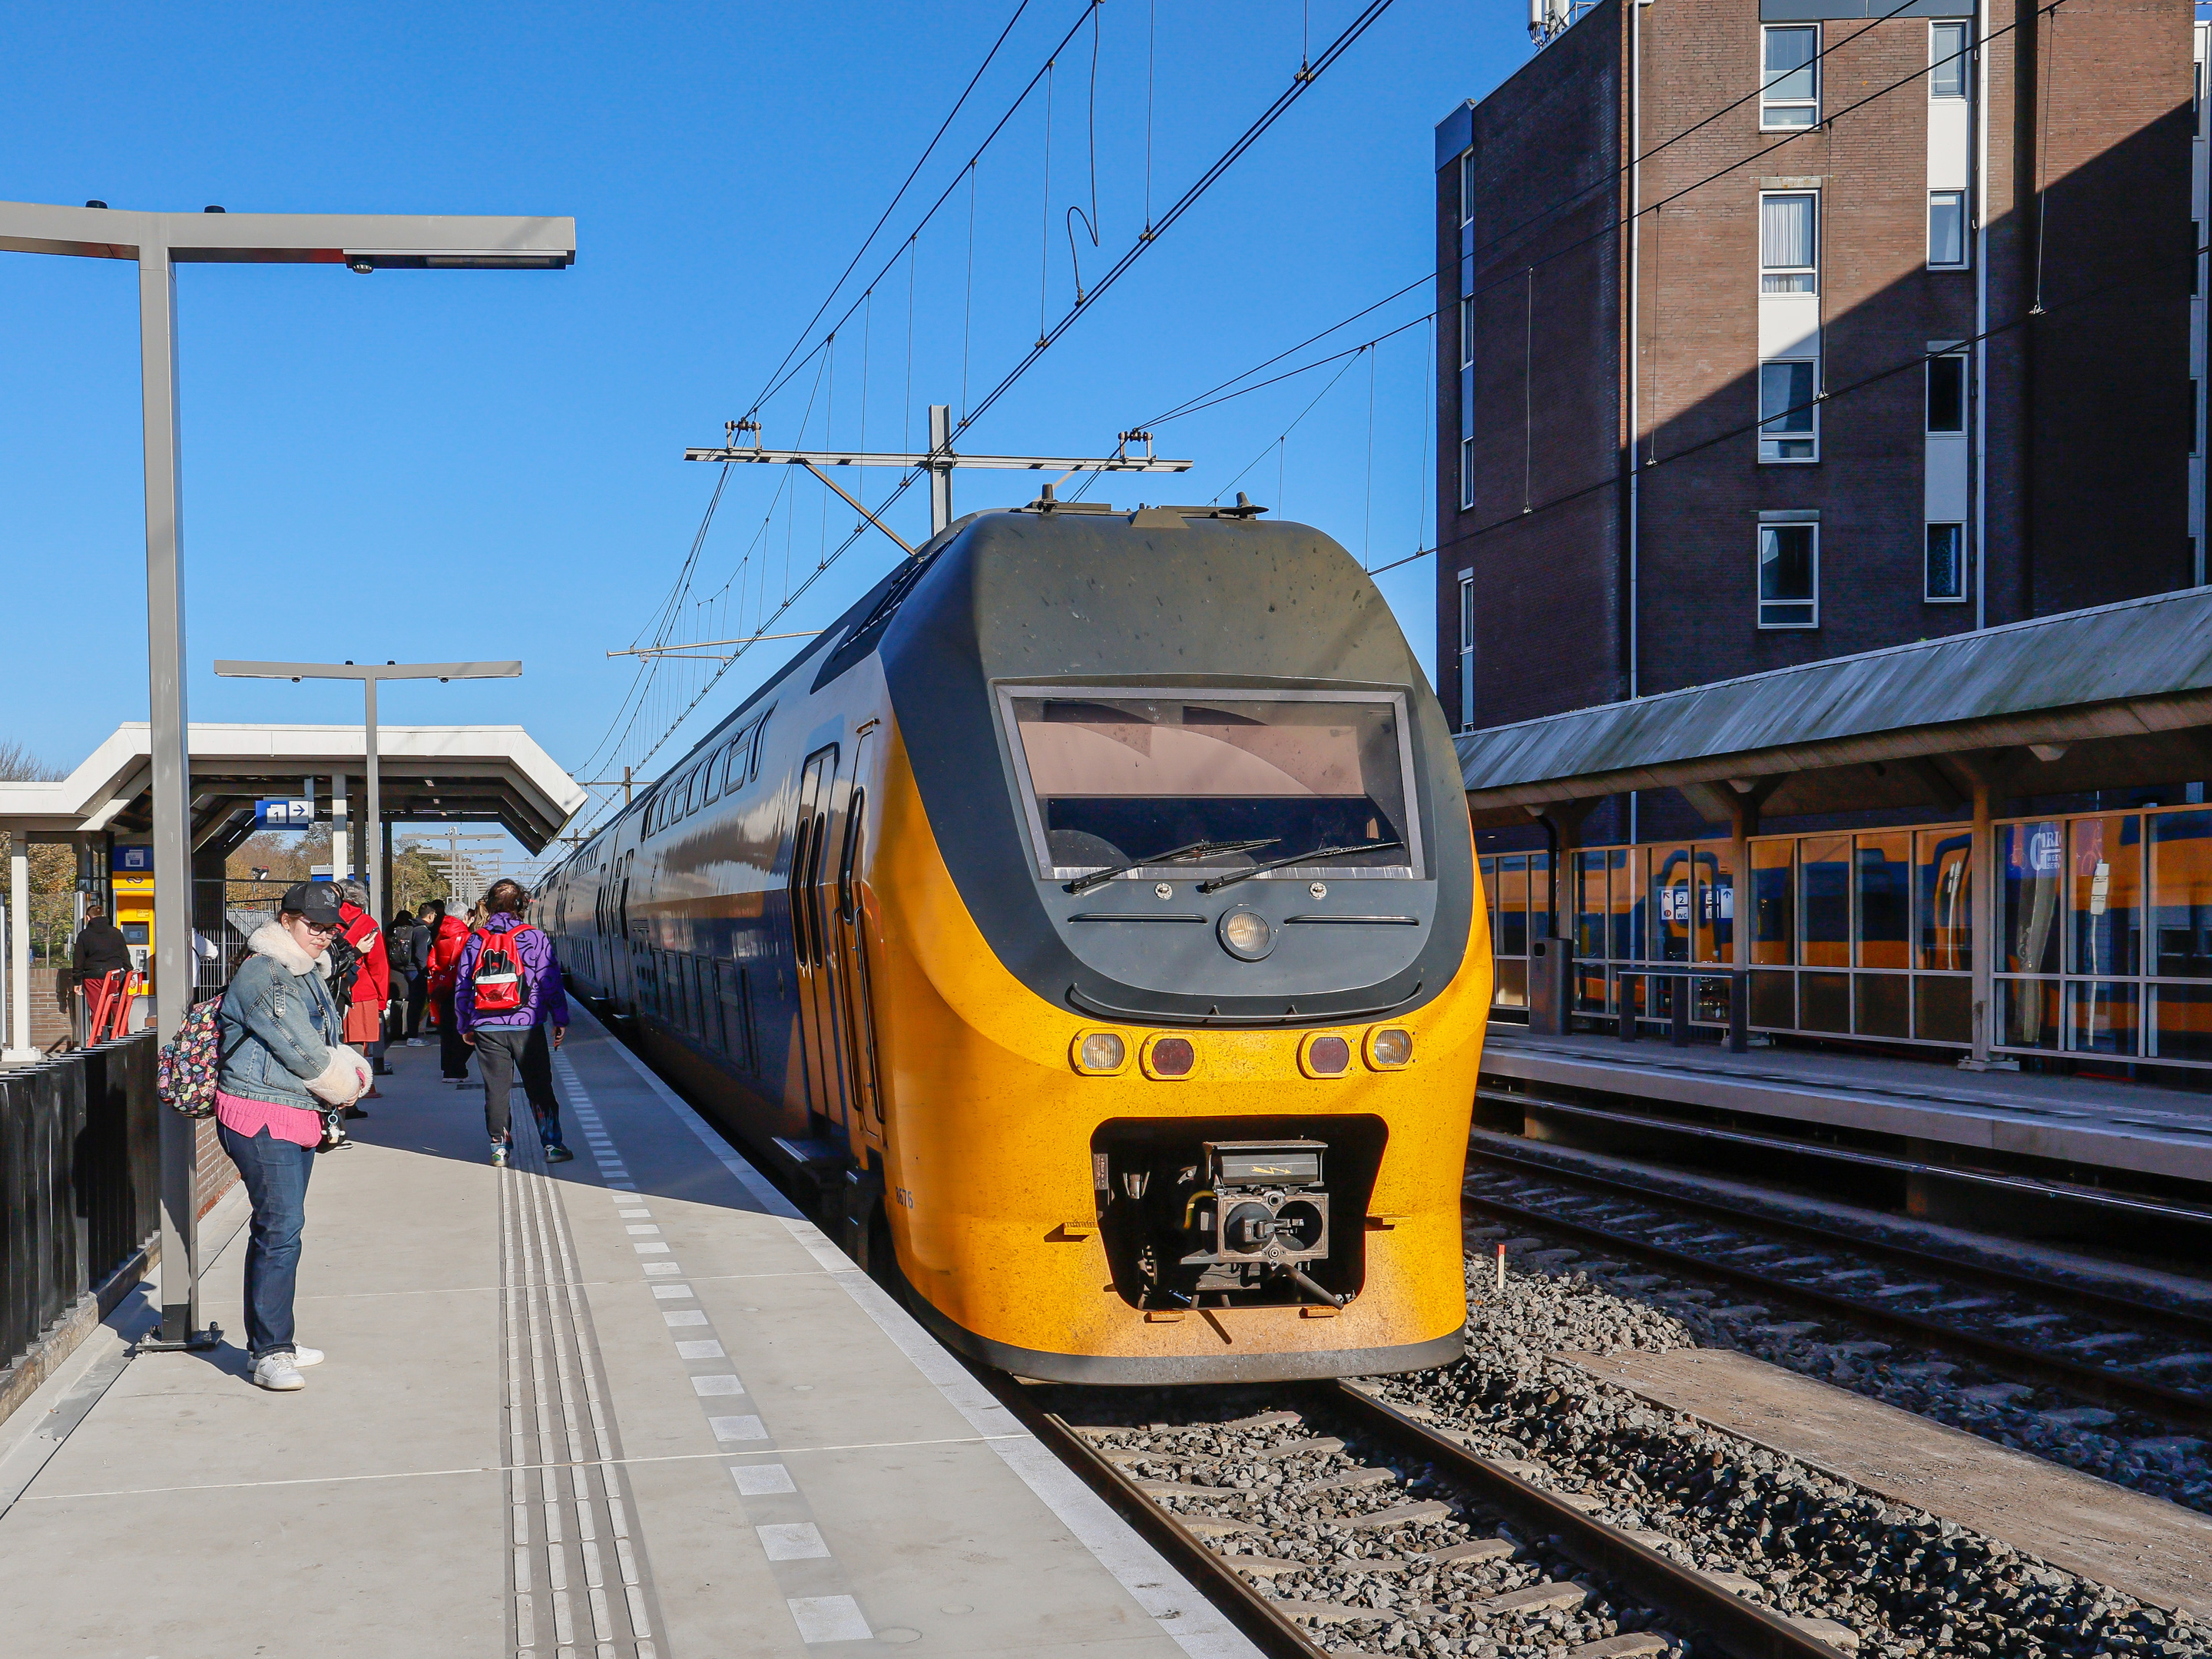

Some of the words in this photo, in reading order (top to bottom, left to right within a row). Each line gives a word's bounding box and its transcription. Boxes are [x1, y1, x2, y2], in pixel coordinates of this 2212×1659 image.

[273, 812, 279, 822] 1
[2030, 832, 2061, 871] GRI
[896, 1186, 913, 1209] 8676
